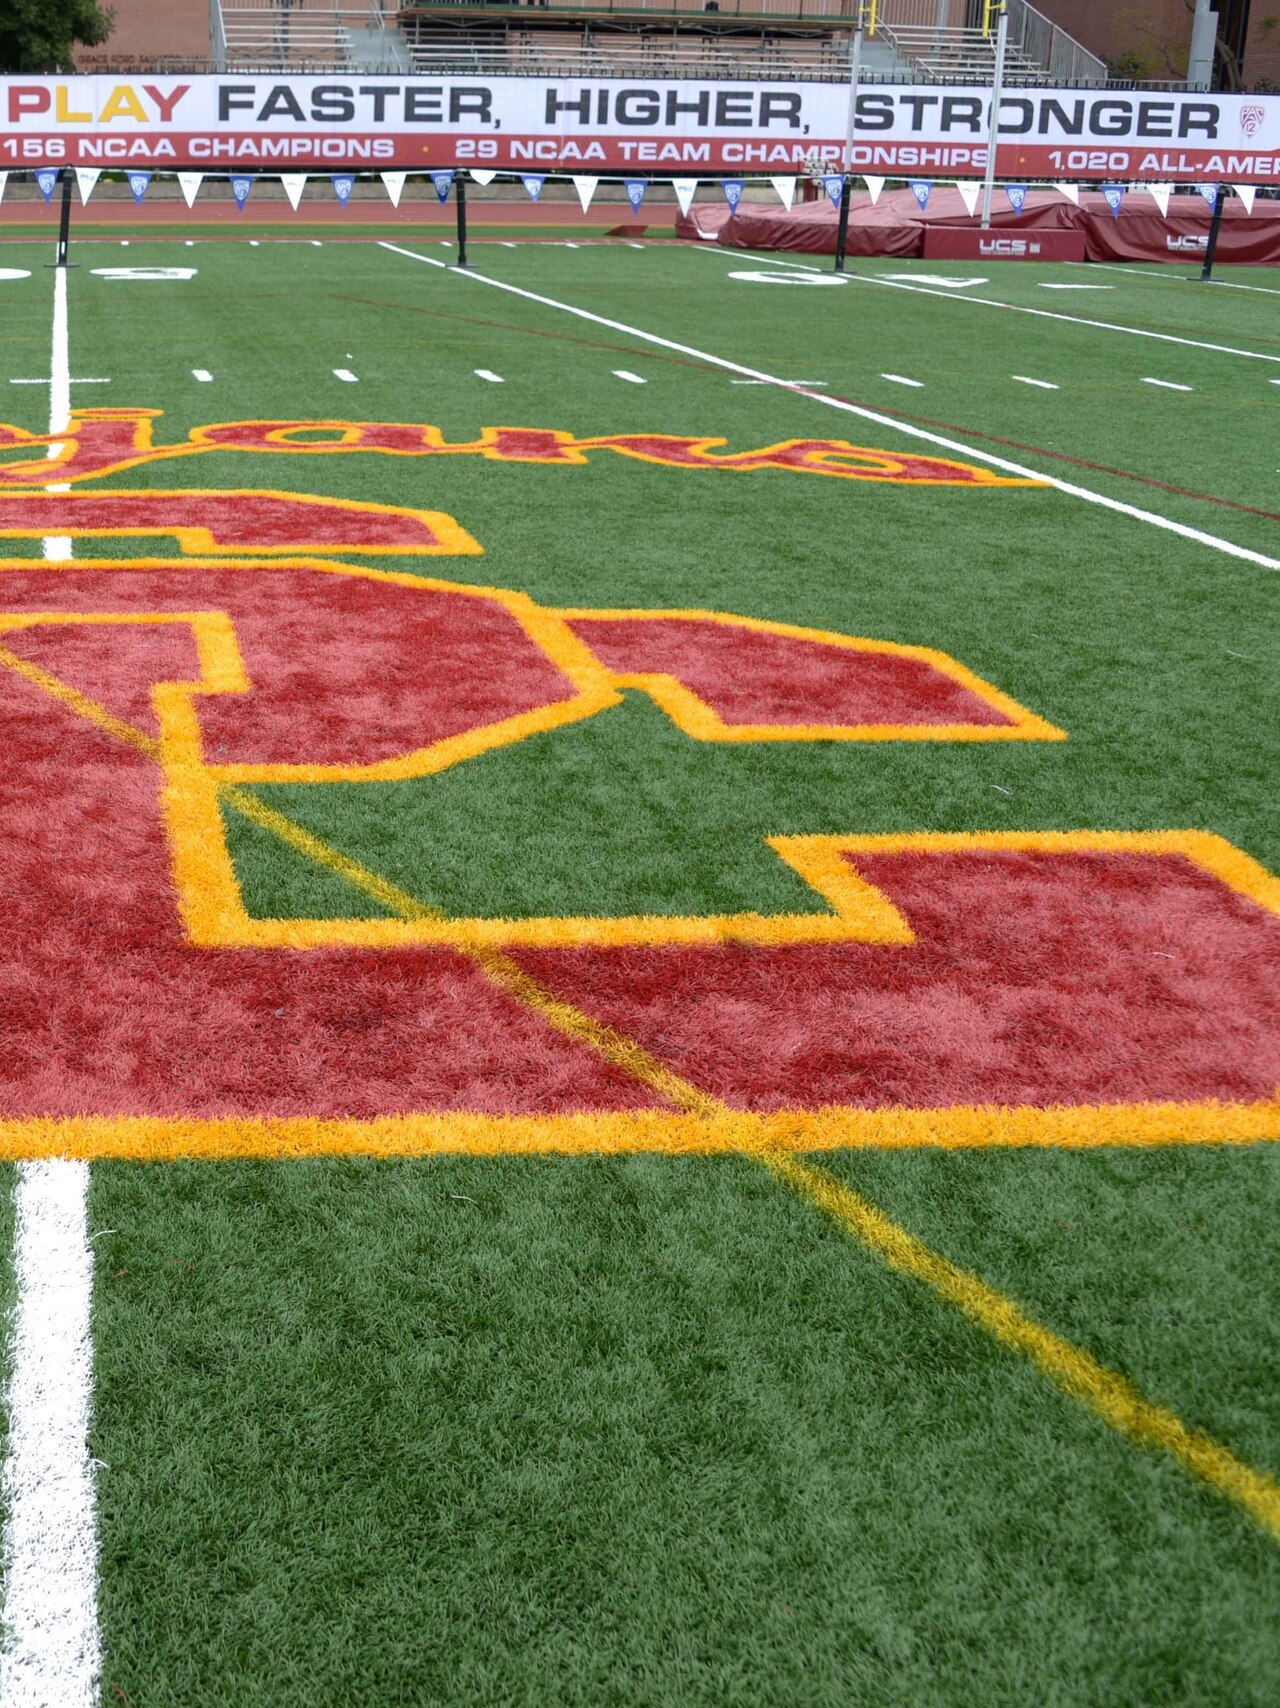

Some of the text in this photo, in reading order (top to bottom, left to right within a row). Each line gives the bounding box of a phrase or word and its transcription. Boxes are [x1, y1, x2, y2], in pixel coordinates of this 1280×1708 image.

[8, 85, 190, 123] PLAY
[218, 85, 500, 129] FASTER,
[544, 88, 810, 135] HIGHER,
[854, 93, 1221, 139] STRONGER
[3, 137, 395, 159] 156 NCAA CHAMPIONS
[455, 139, 988, 169] 29 NCAA TEAM CHAMPIONSHIPS
[1048, 150, 1129, 172] 1,020
[979, 239, 1027, 251] UCS
